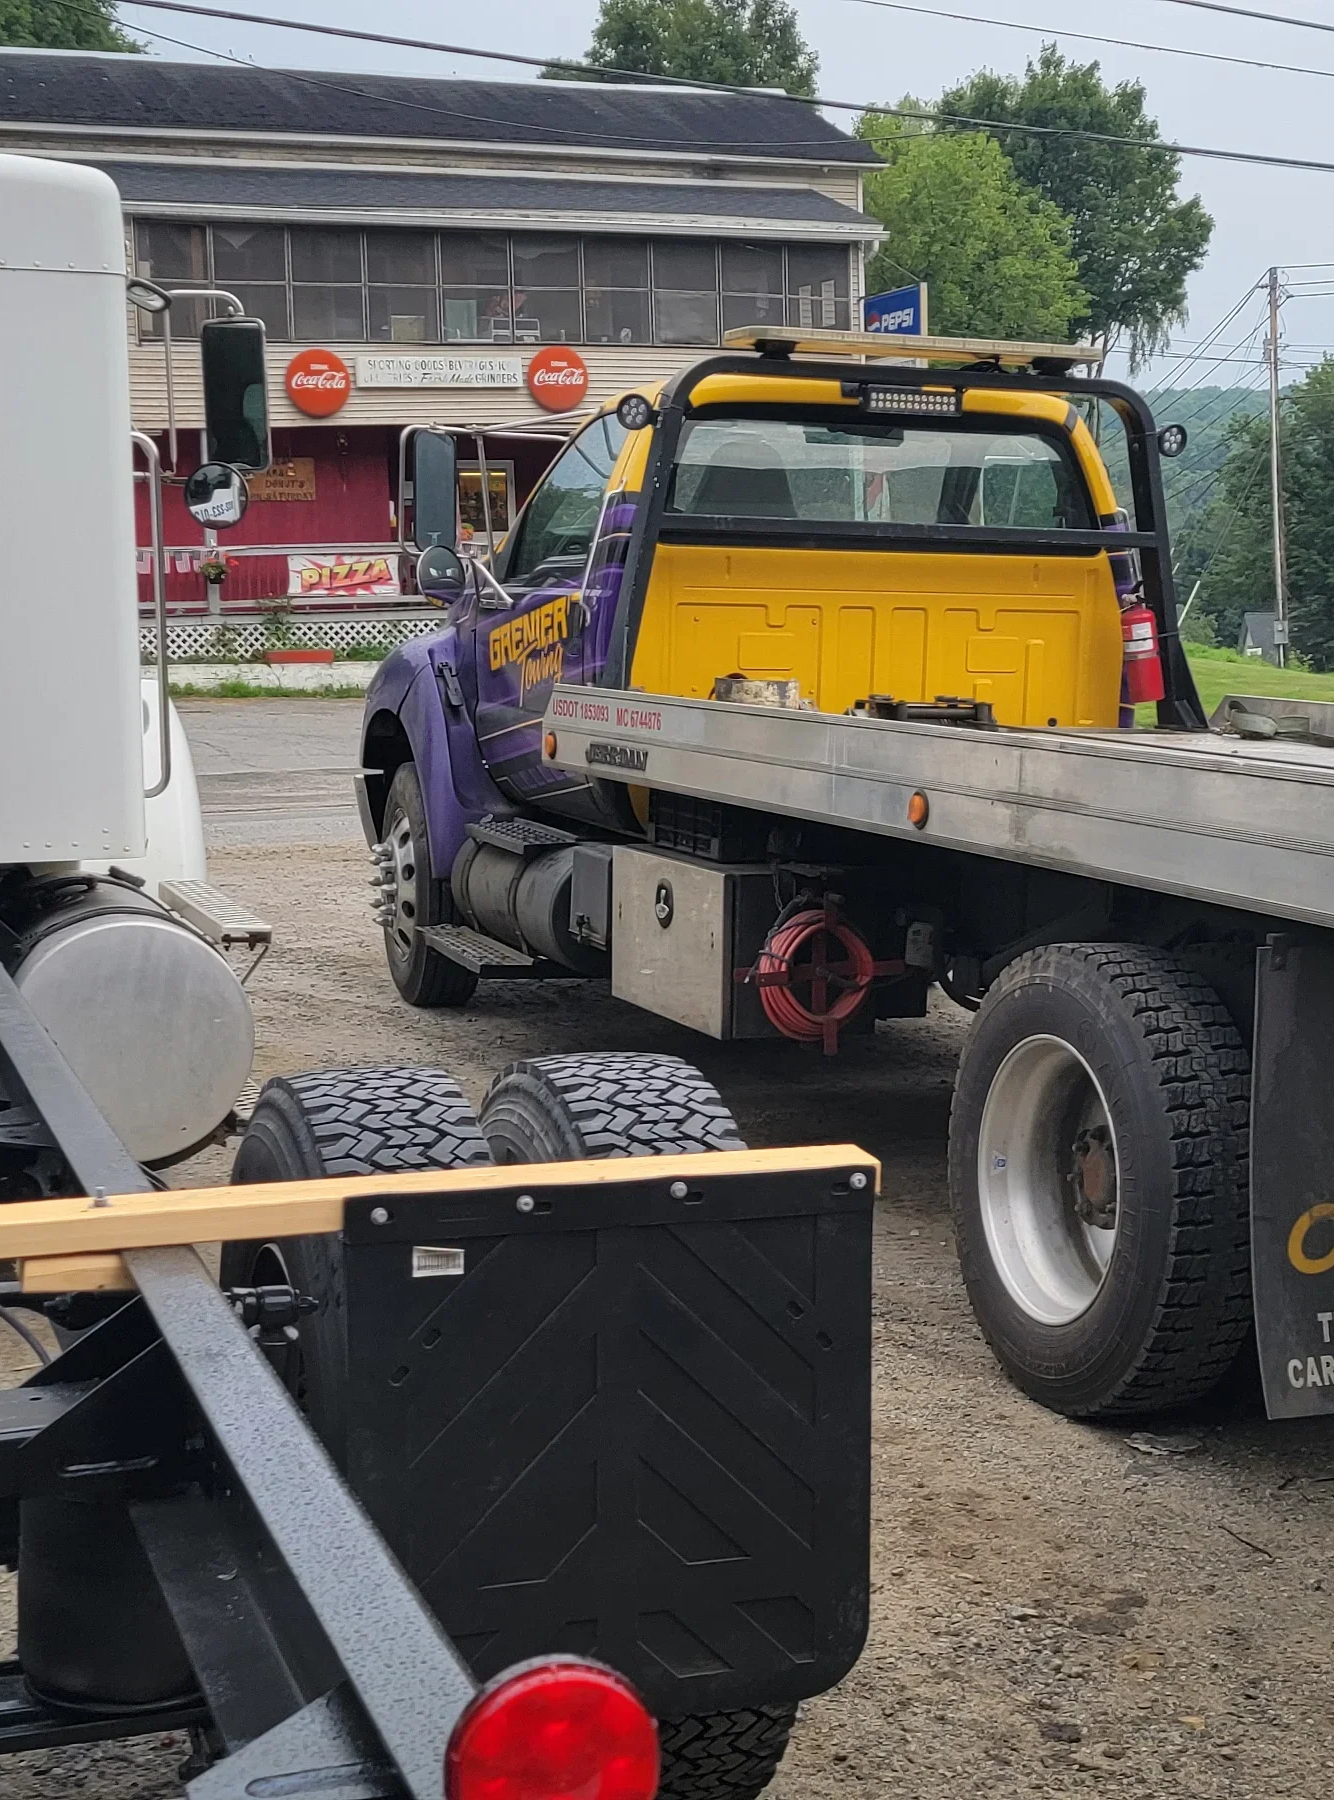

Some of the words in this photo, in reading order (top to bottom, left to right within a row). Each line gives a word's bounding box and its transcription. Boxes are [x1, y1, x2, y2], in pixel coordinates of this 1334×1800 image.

[881, 308, 914, 332] PEPSI
[475, 373, 518, 384] GRINDERS
[301, 558, 393, 592] PIZZA
[516, 640, 564, 708] Towing
[552, 698, 579, 719] USDOT
[580, 701, 609, 723] 1853093
[616, 707, 629, 727] MC
[630, 709, 662, 731] 6744876
